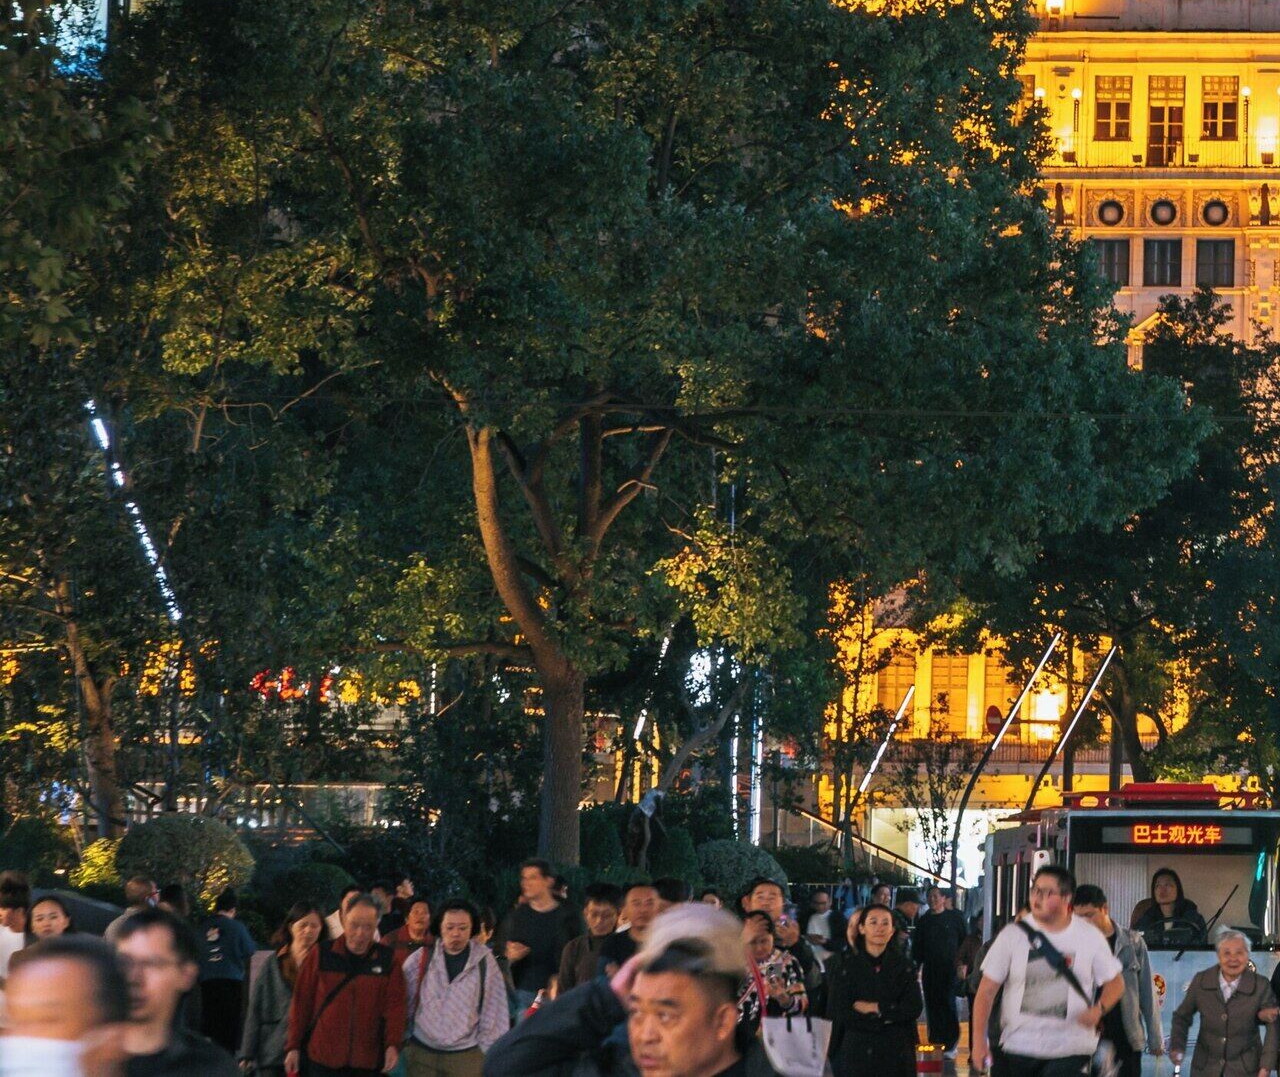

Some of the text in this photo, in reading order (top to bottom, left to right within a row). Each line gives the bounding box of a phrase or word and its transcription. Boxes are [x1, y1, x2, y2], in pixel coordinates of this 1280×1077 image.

[1132, 824, 1222, 845] 巴士观光车
